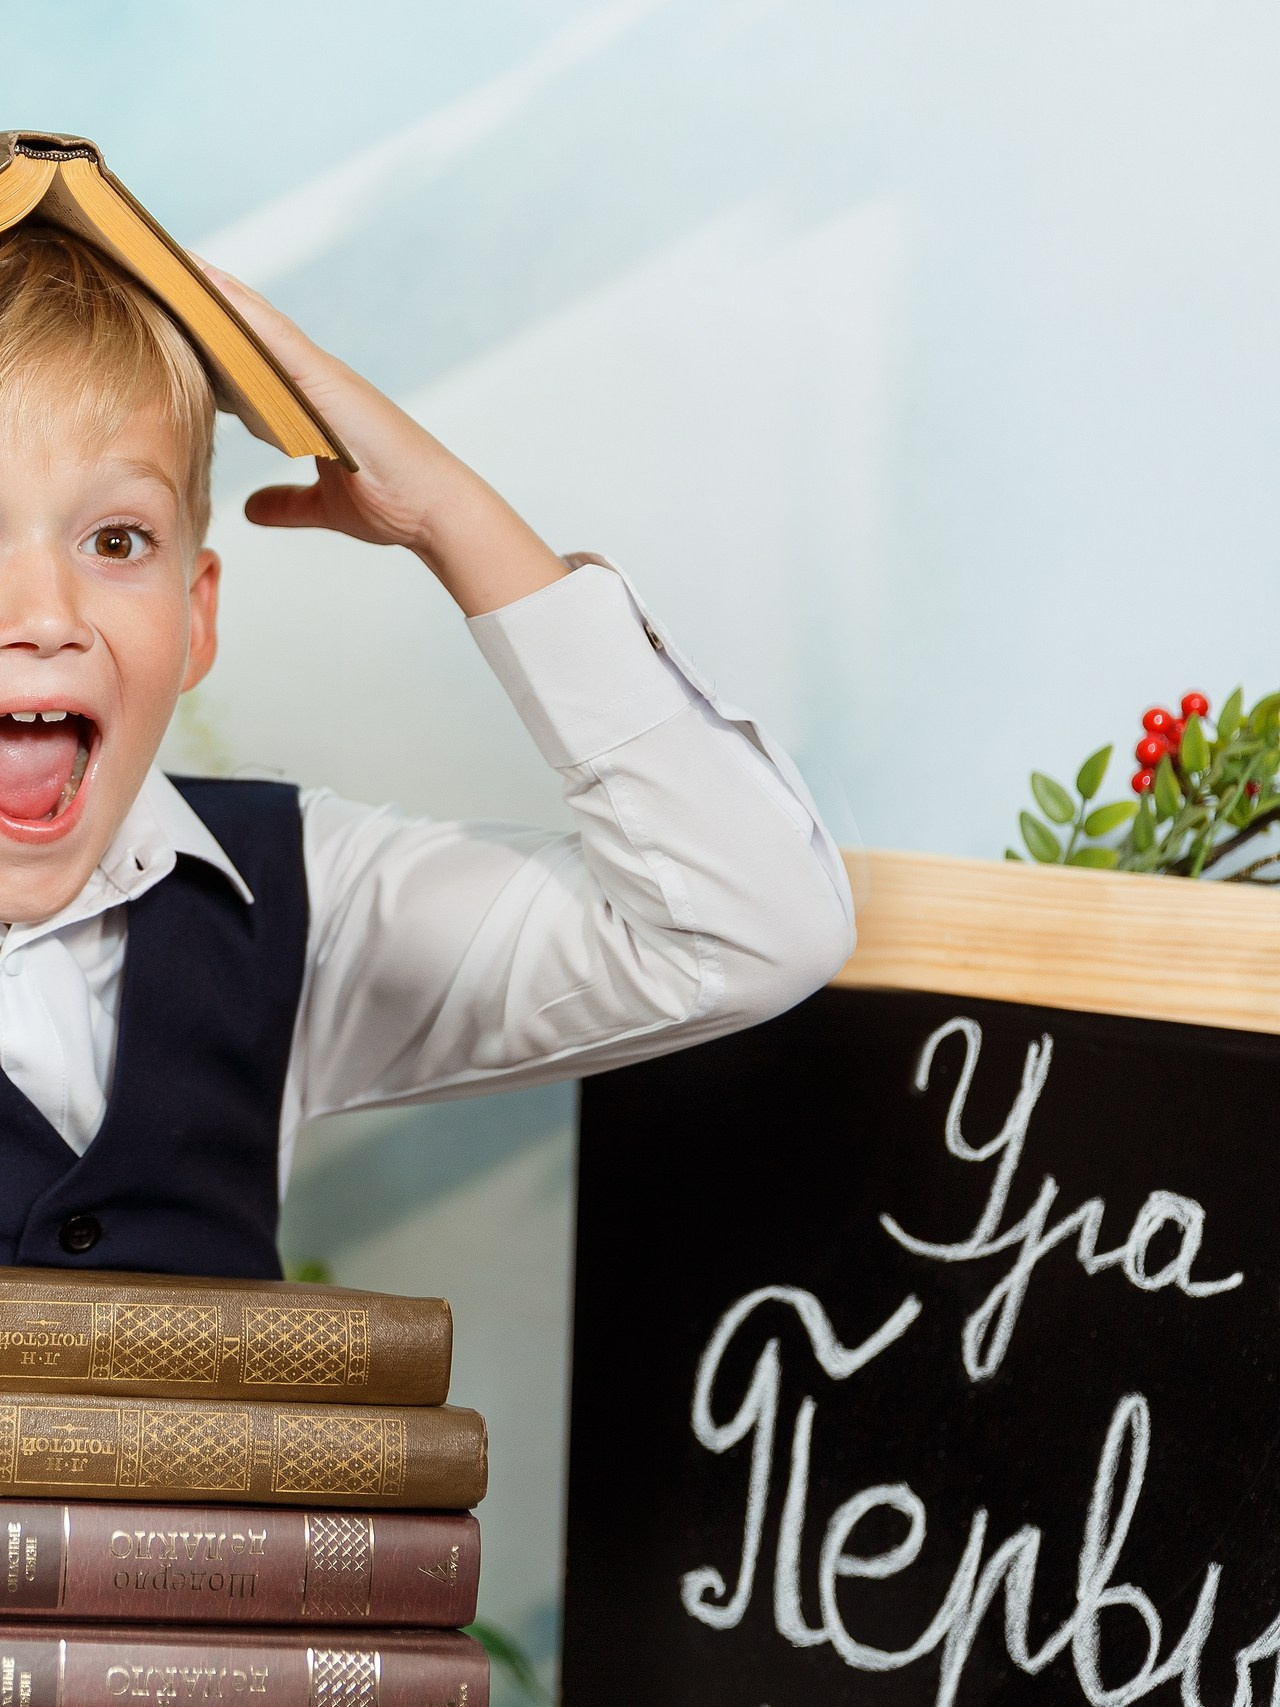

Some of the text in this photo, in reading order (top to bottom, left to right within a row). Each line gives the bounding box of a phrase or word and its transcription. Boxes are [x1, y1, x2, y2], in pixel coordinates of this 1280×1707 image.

[880, 1016, 1244, 1383] Ура
[21, 1437, 116, 1458] ТОЛСТОЙ
[108, 1529, 227, 1561] ЛАКЛО
[113, 1562, 260, 1599] Шодерло
